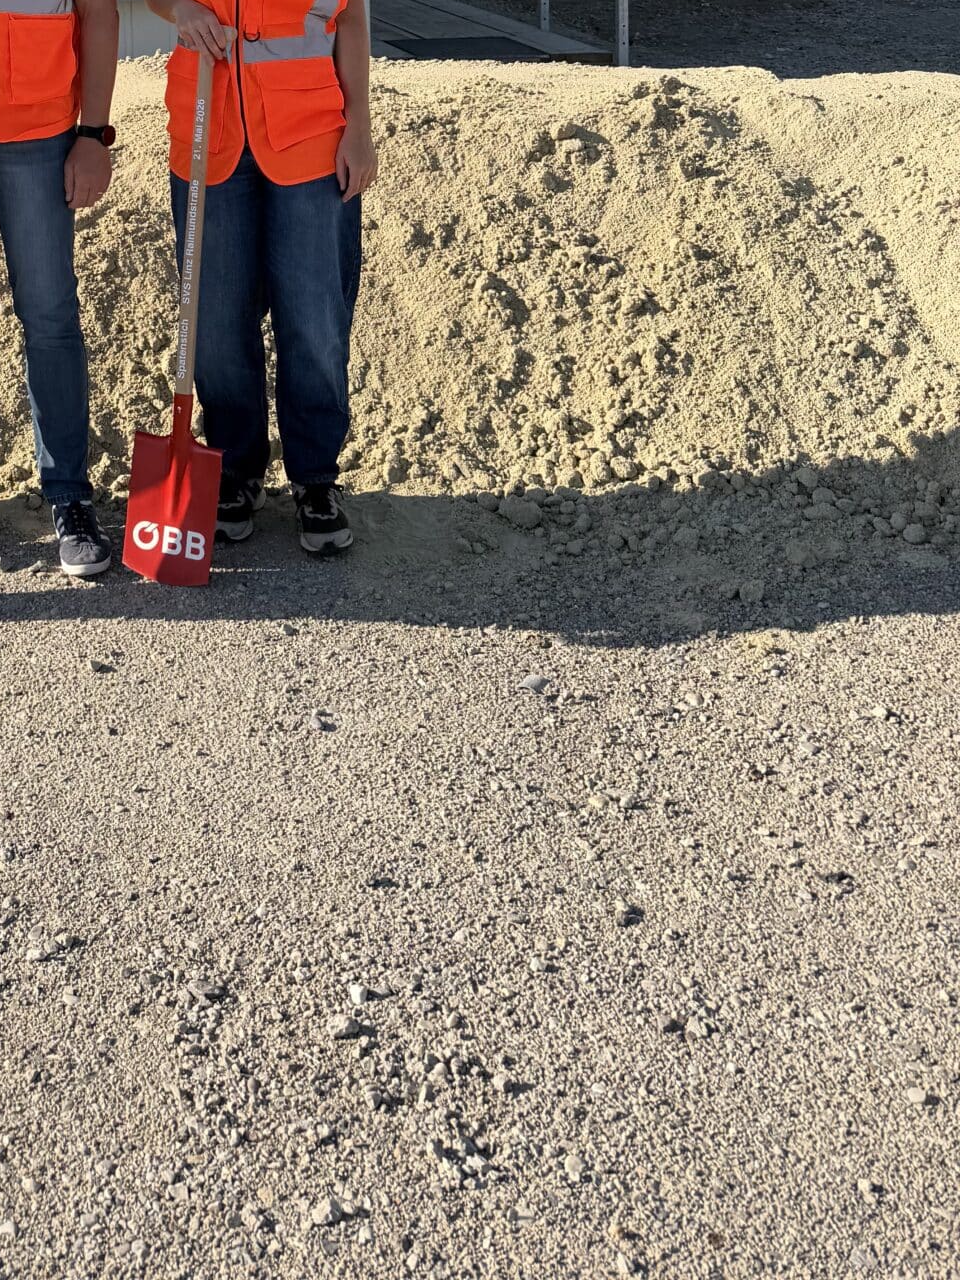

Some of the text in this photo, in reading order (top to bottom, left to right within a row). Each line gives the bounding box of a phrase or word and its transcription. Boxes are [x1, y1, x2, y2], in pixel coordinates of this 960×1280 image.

[194, 122, 204, 143] Mai
[186, 179, 199, 257] Raimundstraße
[184, 259, 193, 280] Linz
[182, 282, 192, 305] SVS
[177, 319, 189, 380] Spatenstich
[132, 520, 206, 561] ÖBB
